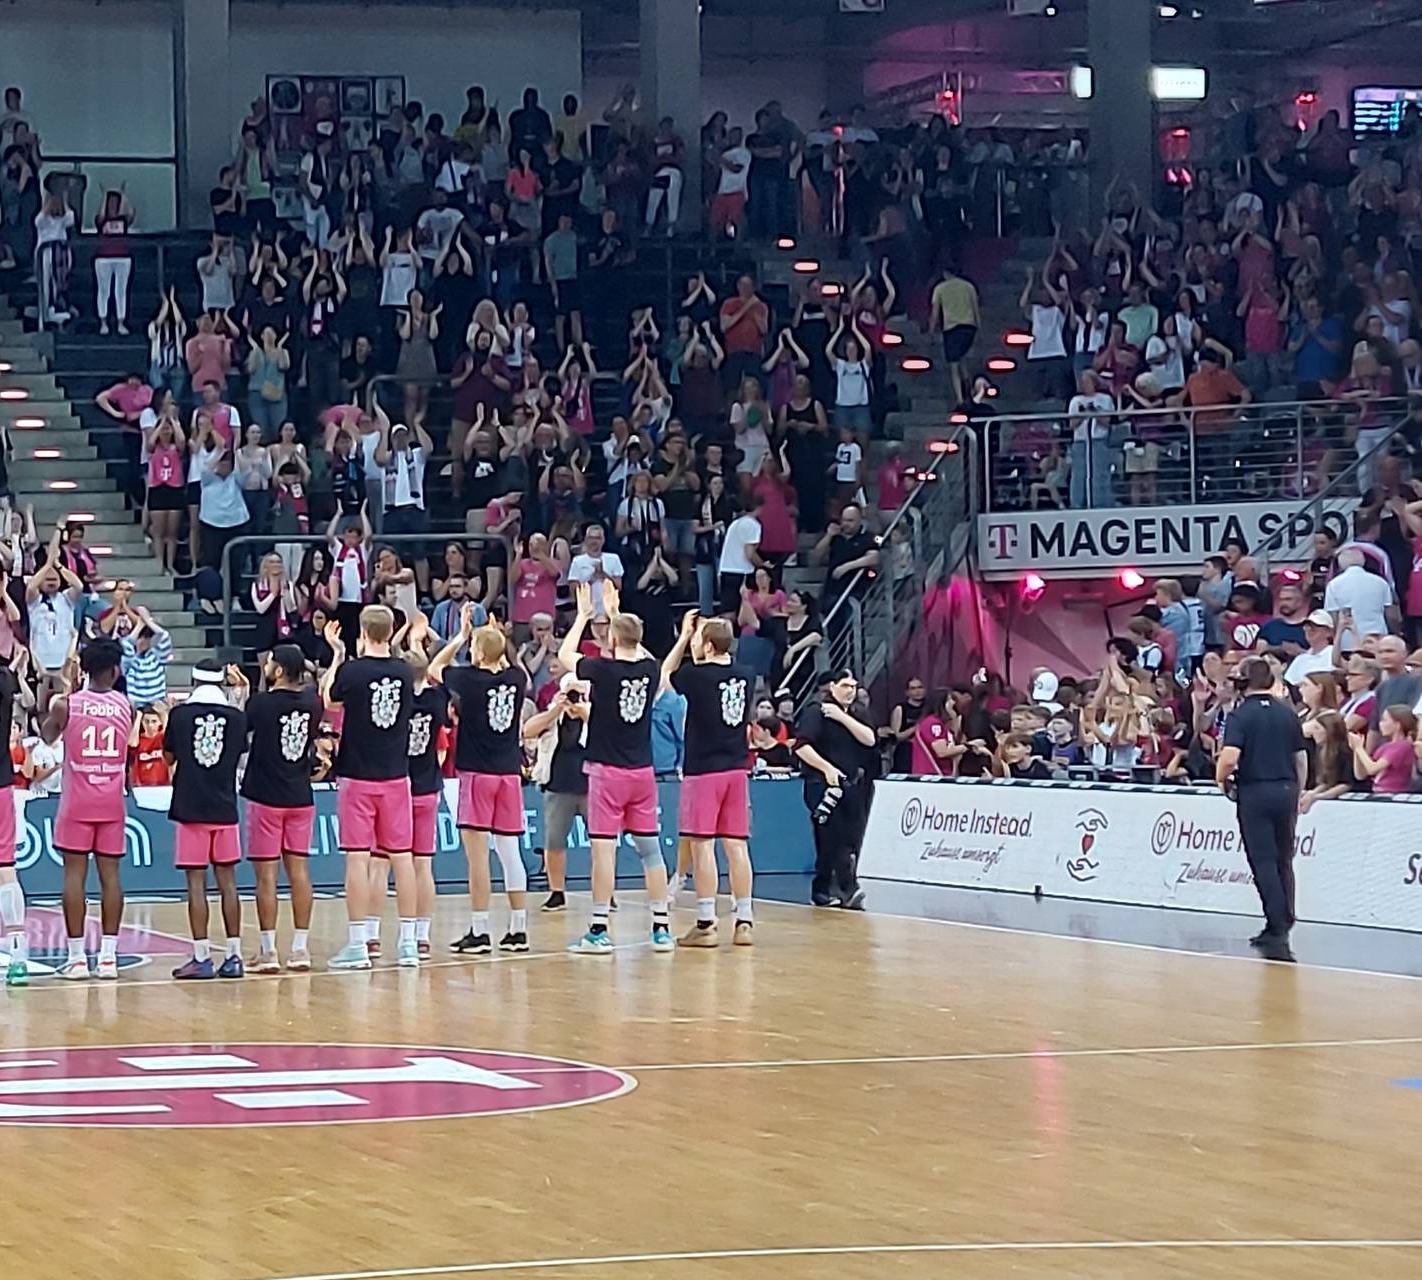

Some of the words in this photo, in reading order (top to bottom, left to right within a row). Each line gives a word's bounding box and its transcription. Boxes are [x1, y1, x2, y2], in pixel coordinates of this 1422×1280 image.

[1030, 514, 1250, 559] MAGENTA
[1258, 510, 1356, 552] SPO
[81, 725, 120, 757] 11
[921, 805, 969, 833] Home
[1176, 821, 1235, 852] Home
